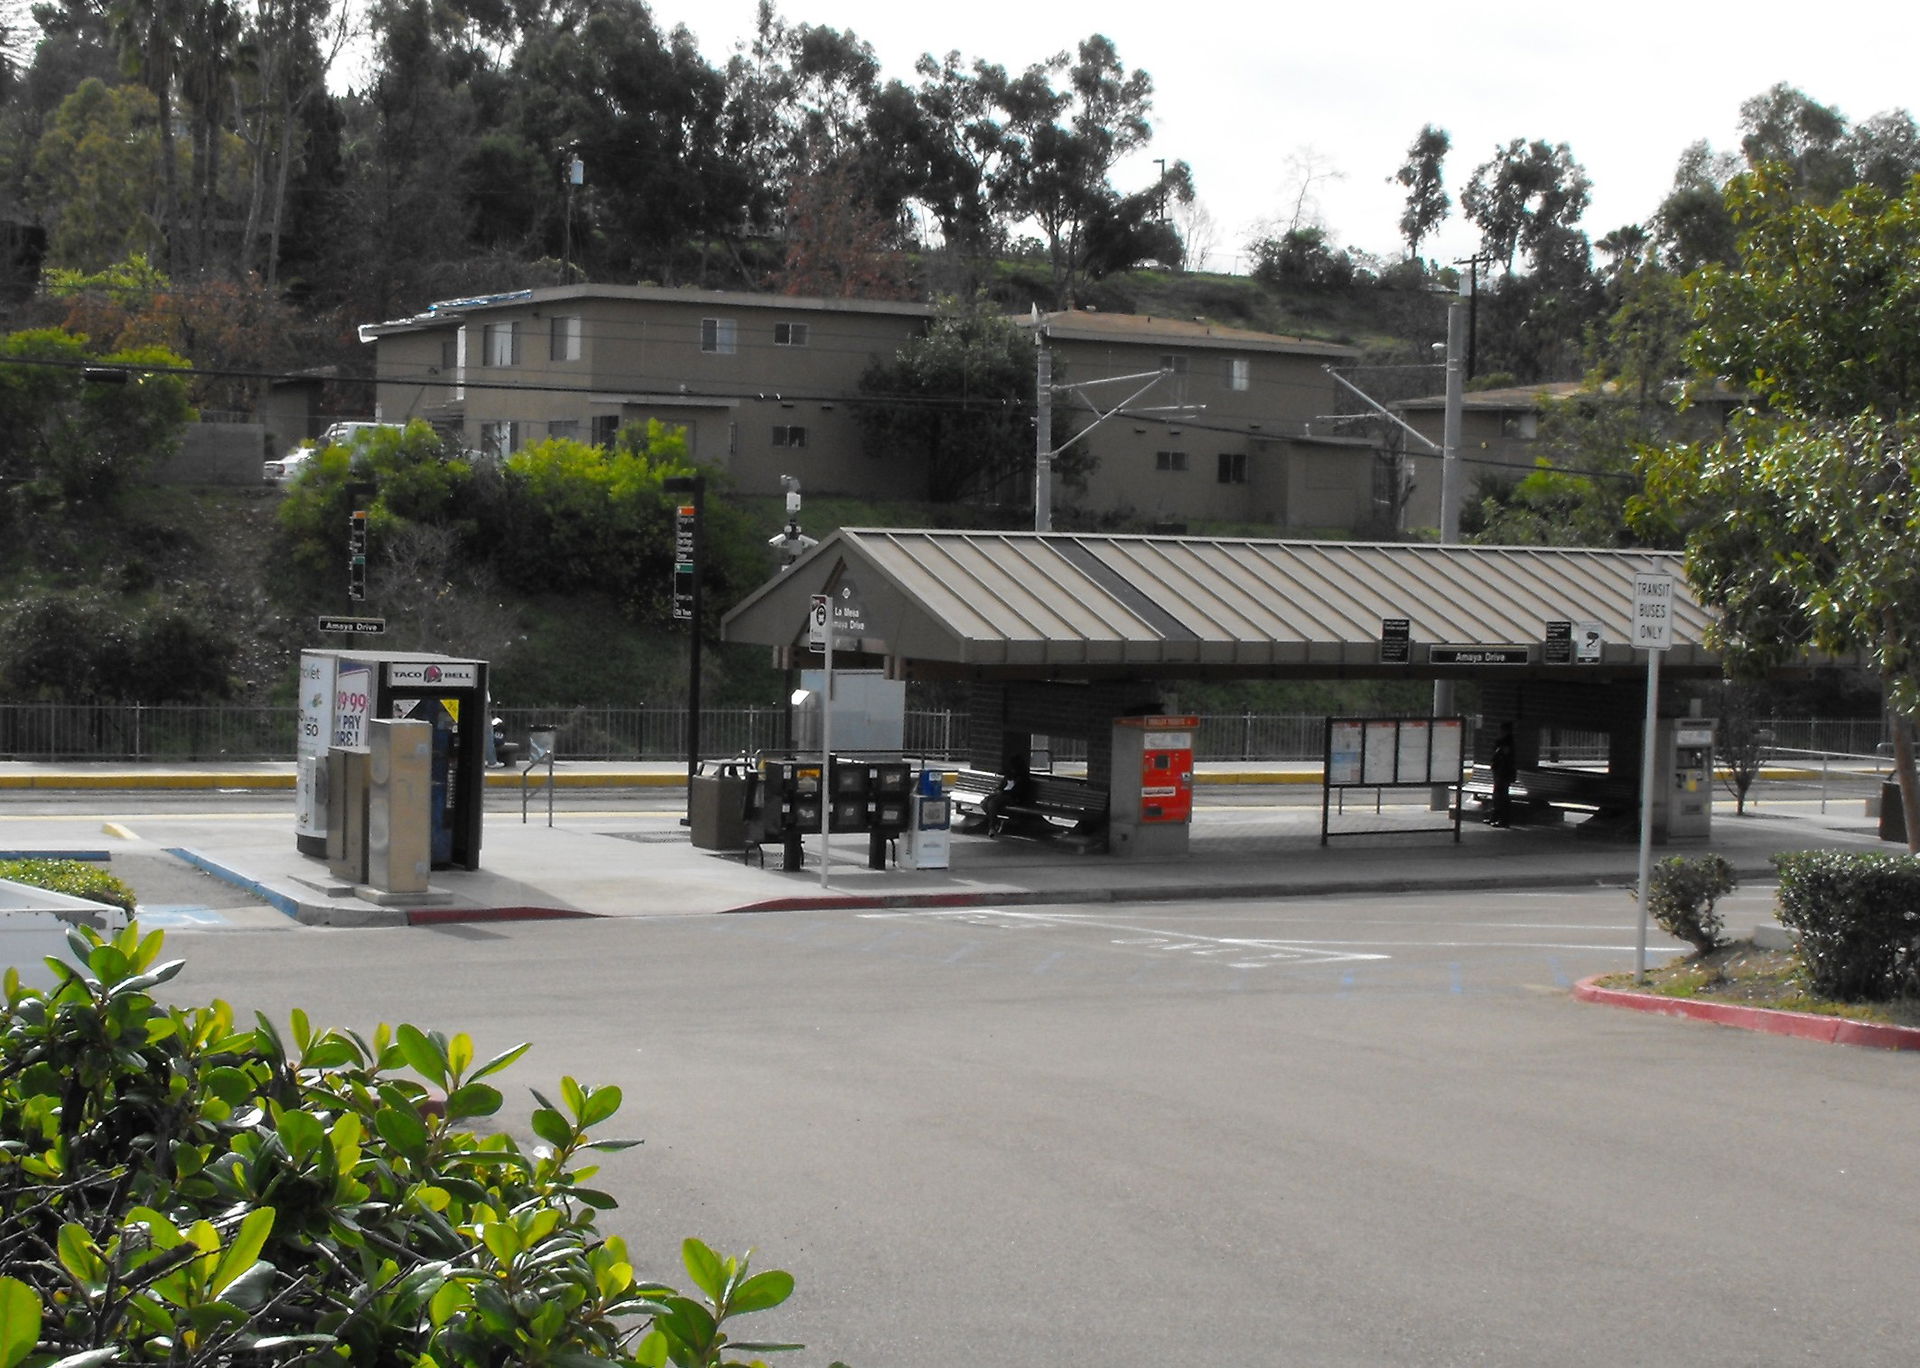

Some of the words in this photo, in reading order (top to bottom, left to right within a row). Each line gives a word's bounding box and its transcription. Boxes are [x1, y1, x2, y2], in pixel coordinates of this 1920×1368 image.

[1637, 582, 1670, 597] TRANSIT
[834, 607, 842, 616] La
[843, 607, 860, 618] Mesa
[1639, 603, 1666, 618] BUSES
[326, 622, 353, 631] Amaya
[356, 622, 378, 631] Drive
[849, 620, 865, 630] Drive
[1640, 624, 1663, 639] ONLY
[1455, 652, 1483, 663] Amaya
[1485, 652, 1506, 662] Drive
[393, 671, 422, 679] TACO
[444, 671, 472, 679] BELL
[343, 715, 361, 730] PAY
